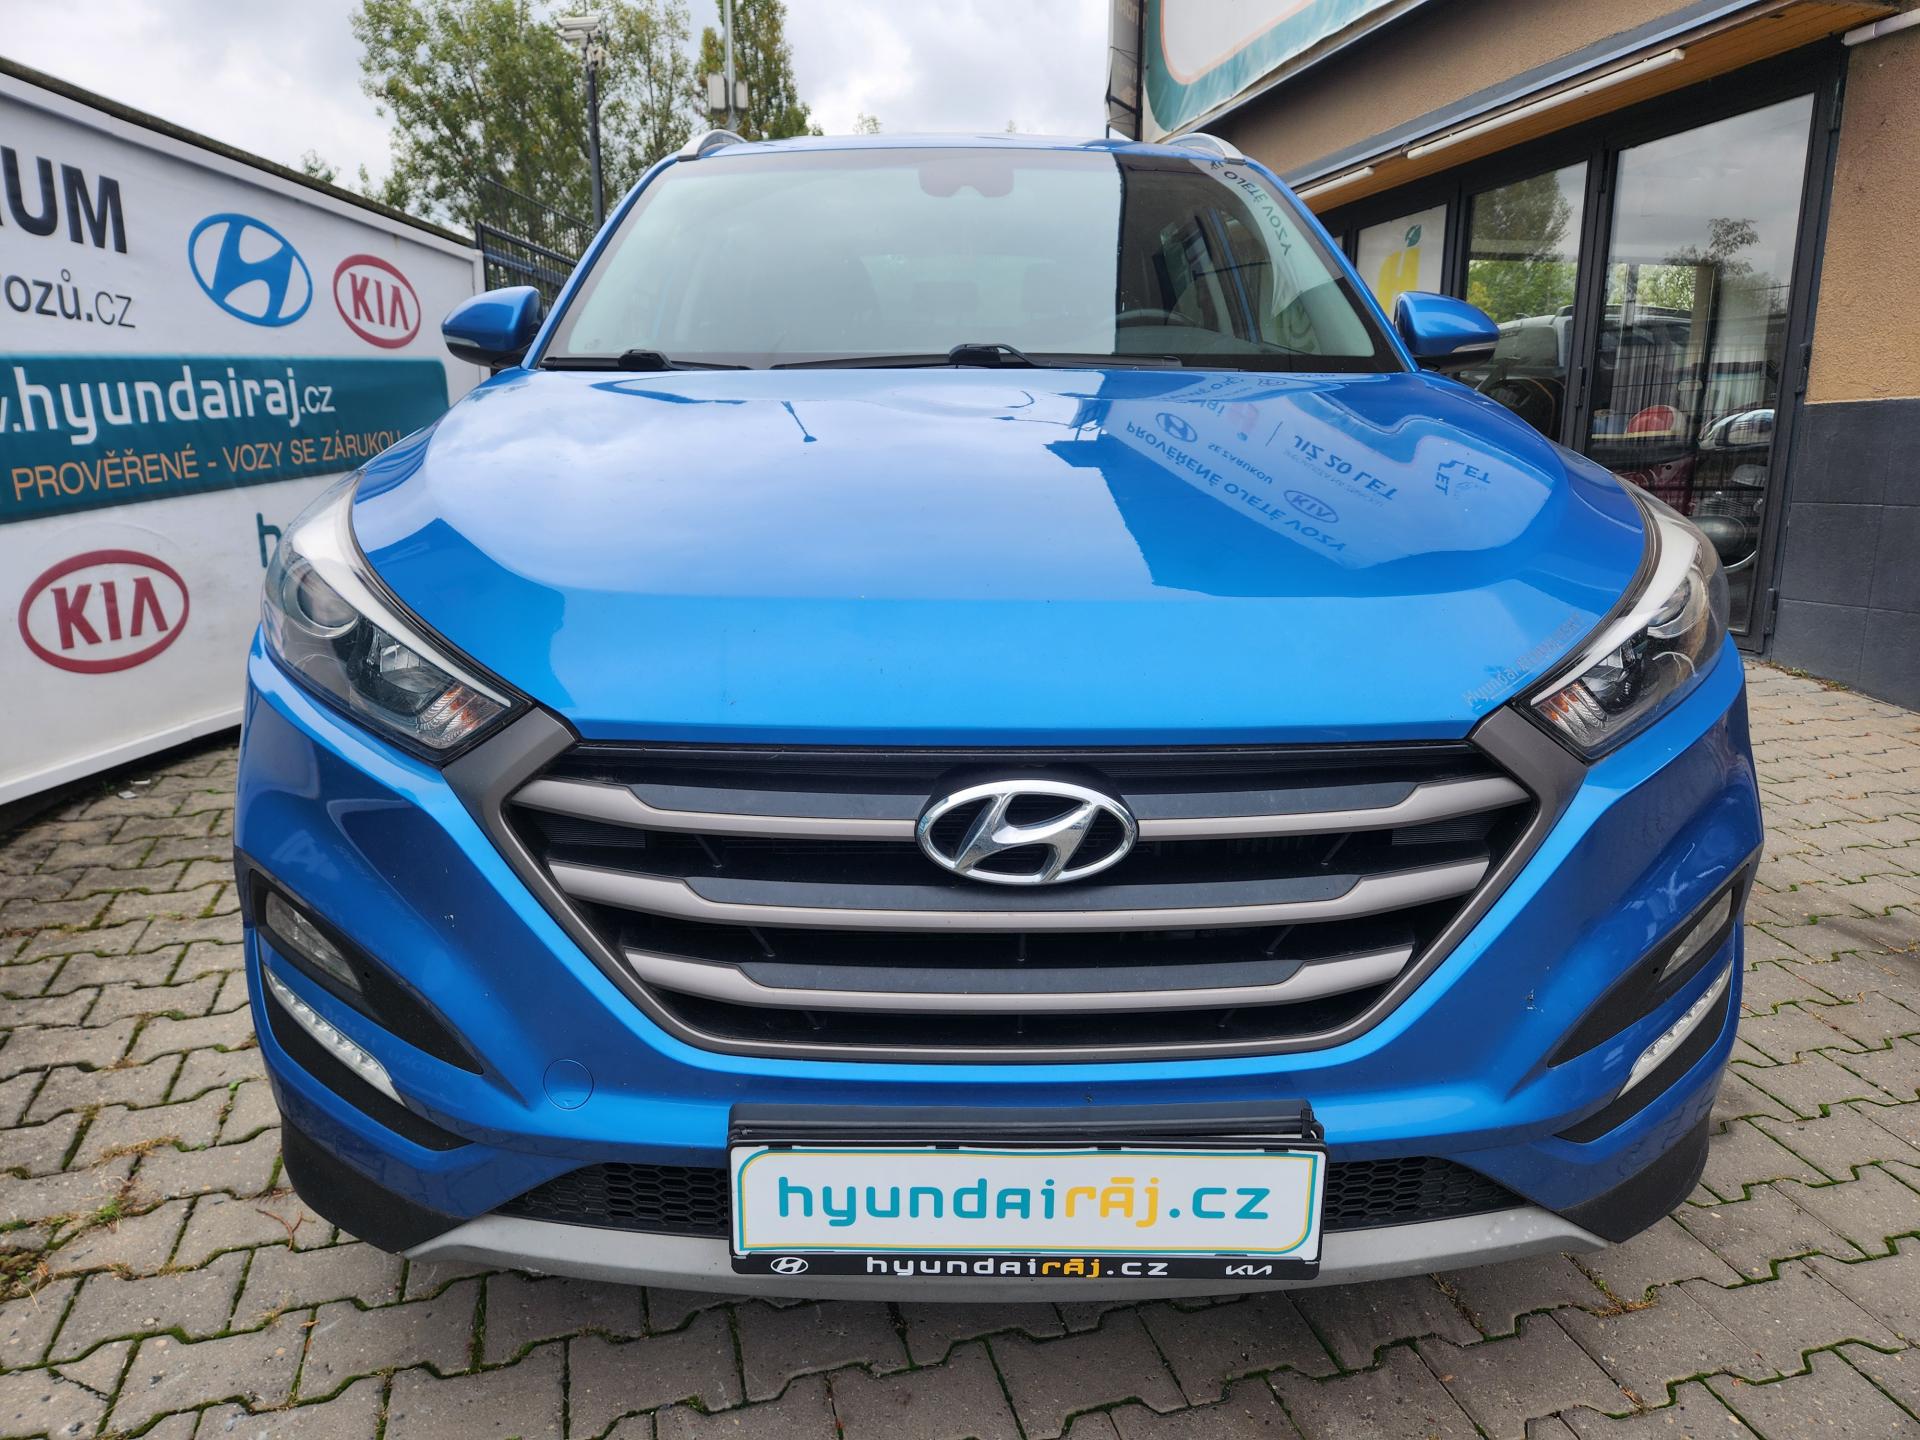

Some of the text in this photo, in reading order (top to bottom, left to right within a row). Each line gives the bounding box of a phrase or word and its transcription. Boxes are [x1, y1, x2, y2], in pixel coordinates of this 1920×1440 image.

[0, 144, 127, 254] UM
[0, 268, 136, 329] ozů.cz
[11, 442, 200, 501] PROVĚŘENÉ
[222, 441, 283, 473] VOZY
[290, 438, 317, 465] SE
[51, 578, 168, 651] KIA
